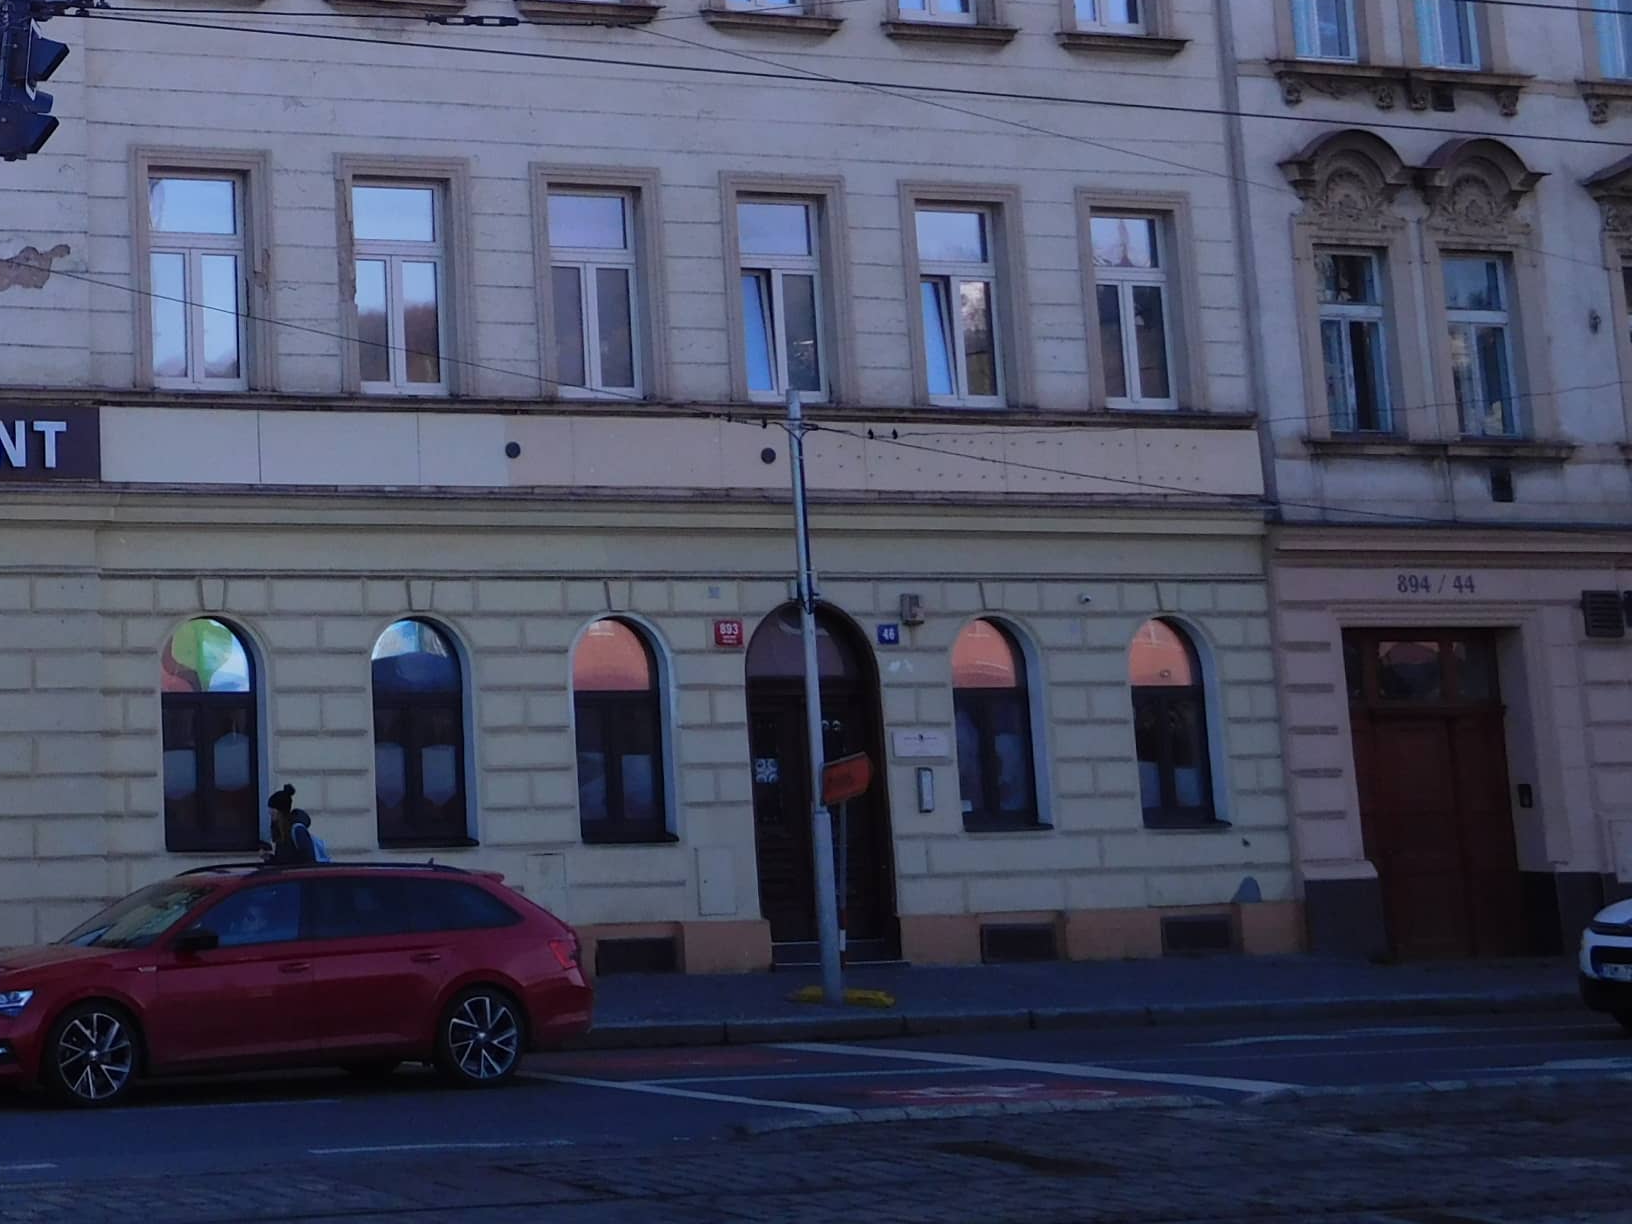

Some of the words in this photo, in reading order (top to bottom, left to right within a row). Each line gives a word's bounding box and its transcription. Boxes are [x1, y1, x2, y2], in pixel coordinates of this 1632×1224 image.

[1397, 574, 1431, 593] 894
[1453, 574, 1475, 594] 44
[719, 623, 739, 635] 893
[882, 628, 896, 641] 46
